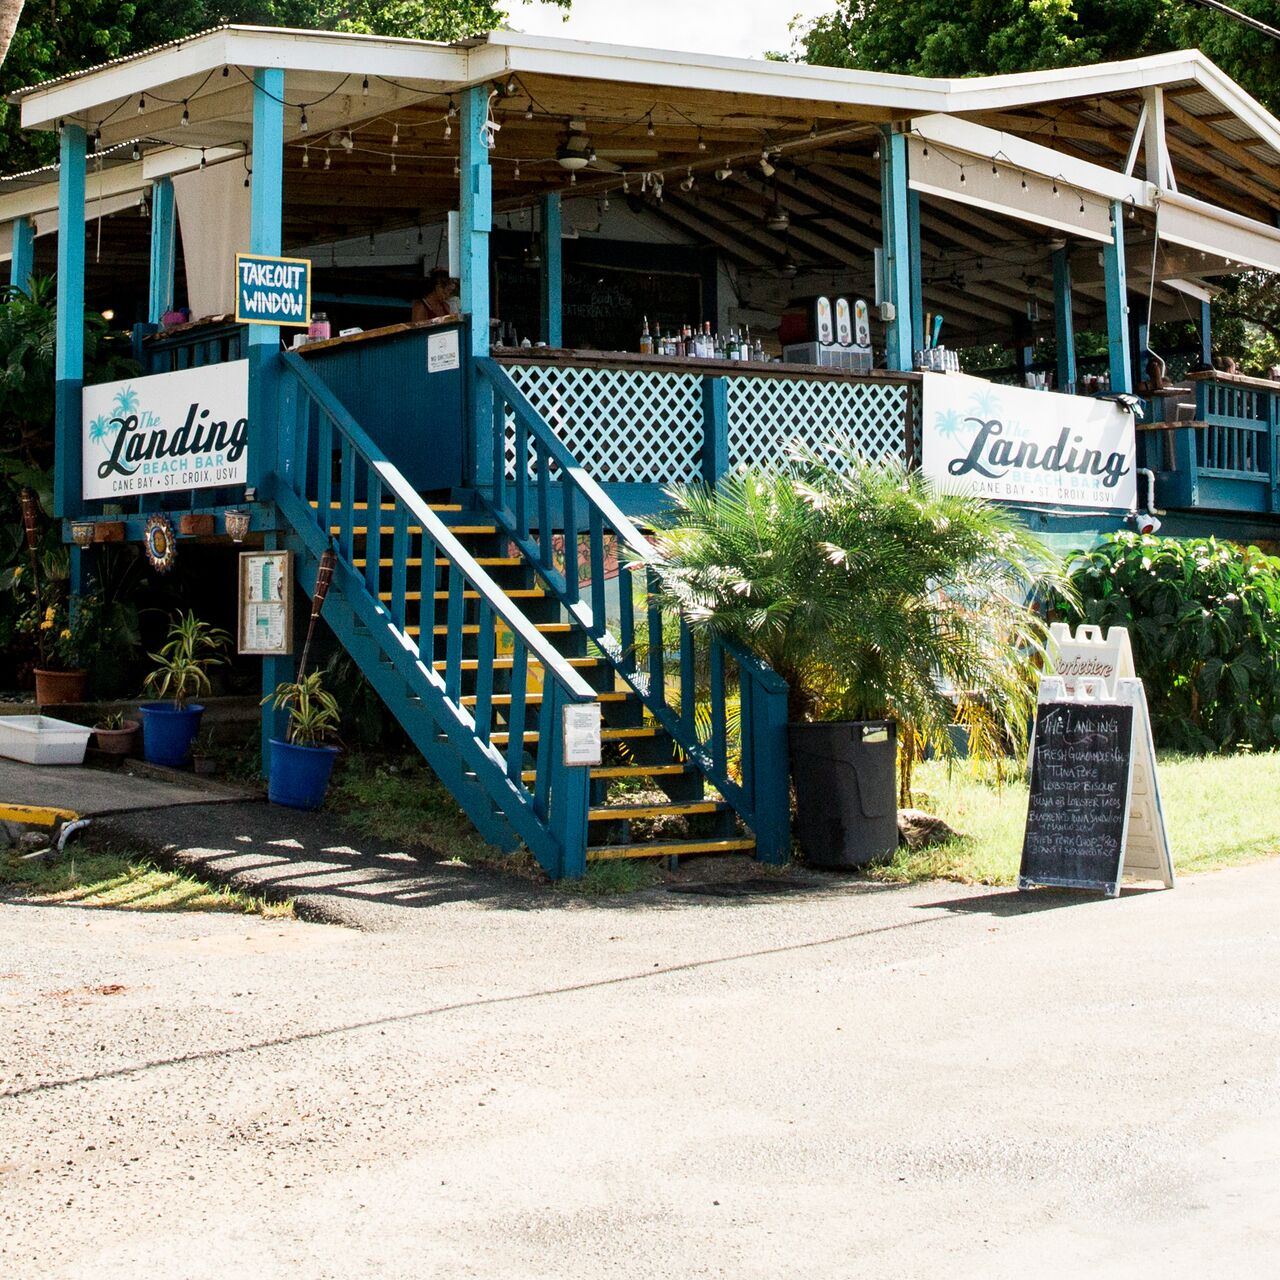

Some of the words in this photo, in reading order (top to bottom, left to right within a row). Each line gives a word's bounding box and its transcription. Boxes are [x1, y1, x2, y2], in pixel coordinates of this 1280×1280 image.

[239, 262, 305, 290] TAKEOUT
[243, 290, 303, 316] WINDOW
[140, 411, 160, 428] The
[98, 403, 248, 479] Landing
[948, 417, 1130, 488] Landing
[143, 459, 188, 475] BEACH
[195, 454, 224, 469] BAR
[113, 479, 133, 492] CANE
[138, 477, 153, 489] BAY
[164, 474, 178, 486] ST.
[182, 471, 212, 484] CROIX,
[216, 467, 237, 480] USVI
[972, 480, 1000, 494] CANE
[1006, 482, 1025, 495] BAY
[1012, 471, 1065, 487] BEACH
[1071, 477, 1101, 489] BAR
[1039, 708, 1064, 735] THE
[1066, 711, 1118, 734] LANDING
[1043, 780, 1080, 791] LOBSTER
